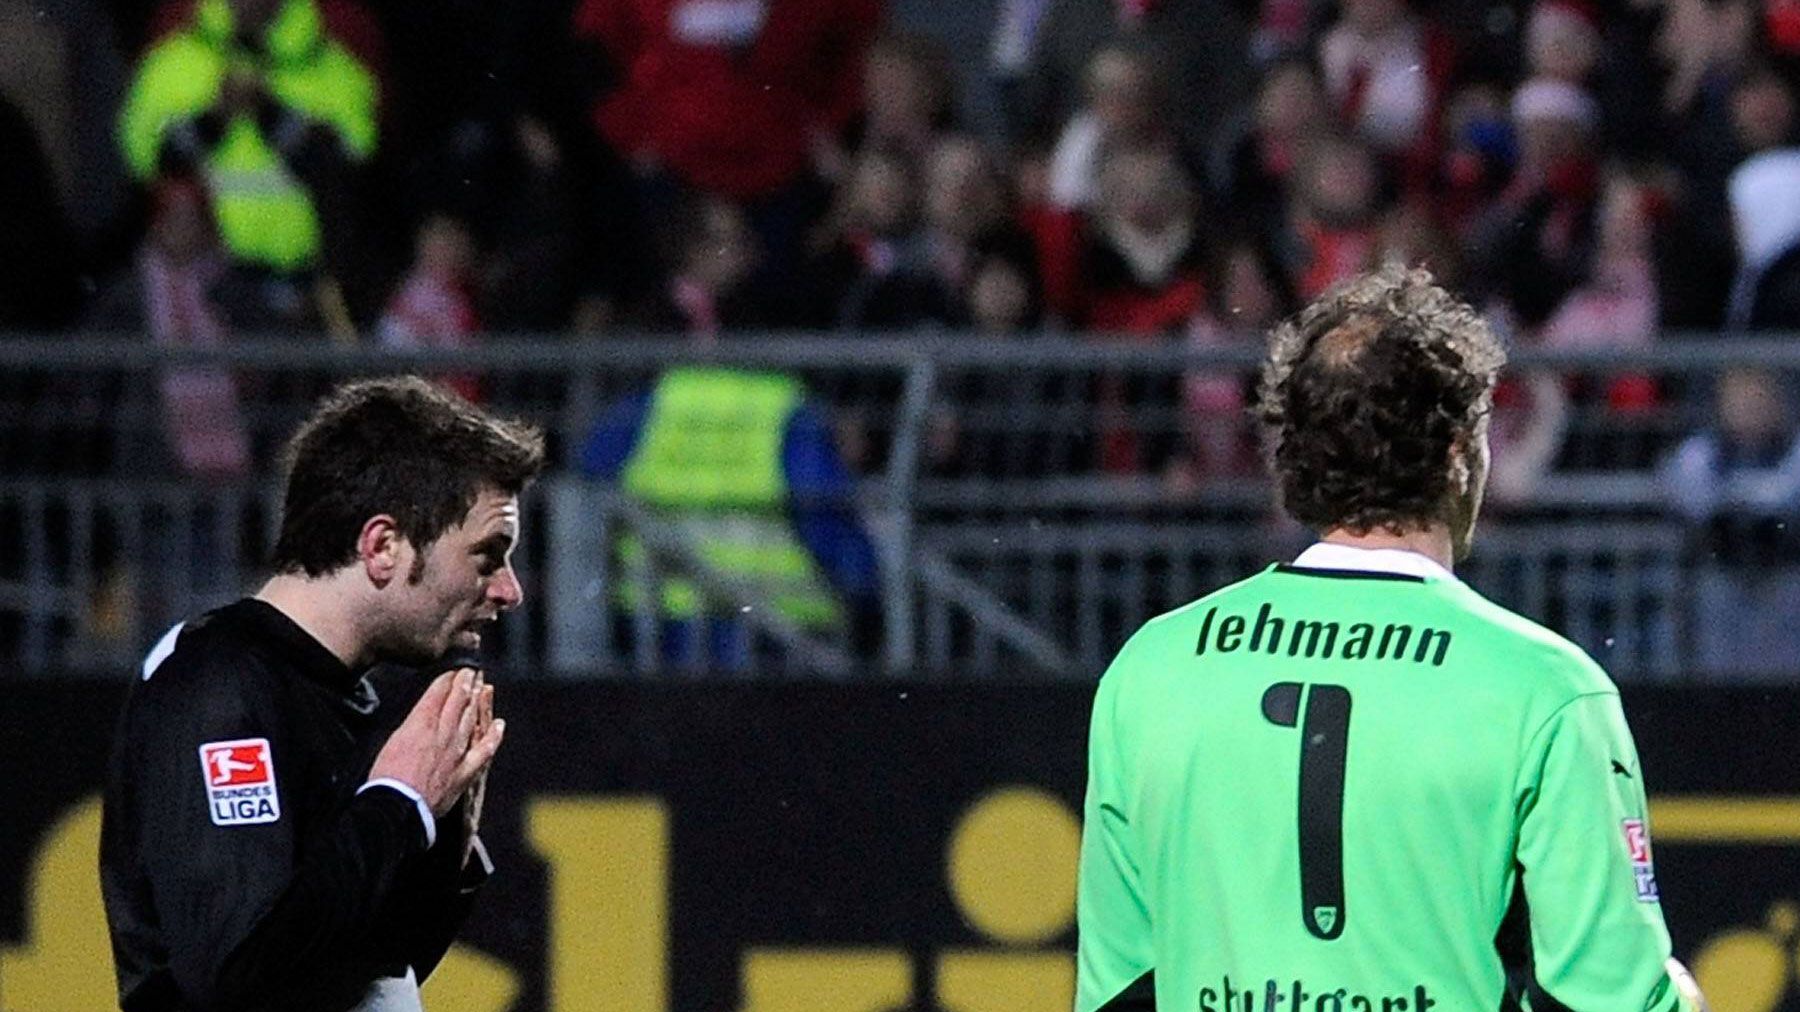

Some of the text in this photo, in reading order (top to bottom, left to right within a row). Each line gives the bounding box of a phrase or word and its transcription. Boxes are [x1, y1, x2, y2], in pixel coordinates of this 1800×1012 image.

[1195, 602, 1452, 667] lehmann
[213, 786, 273, 800] BUNDES
[215, 798, 276, 820] LIGA
[1260, 680, 1353, 942] 1
